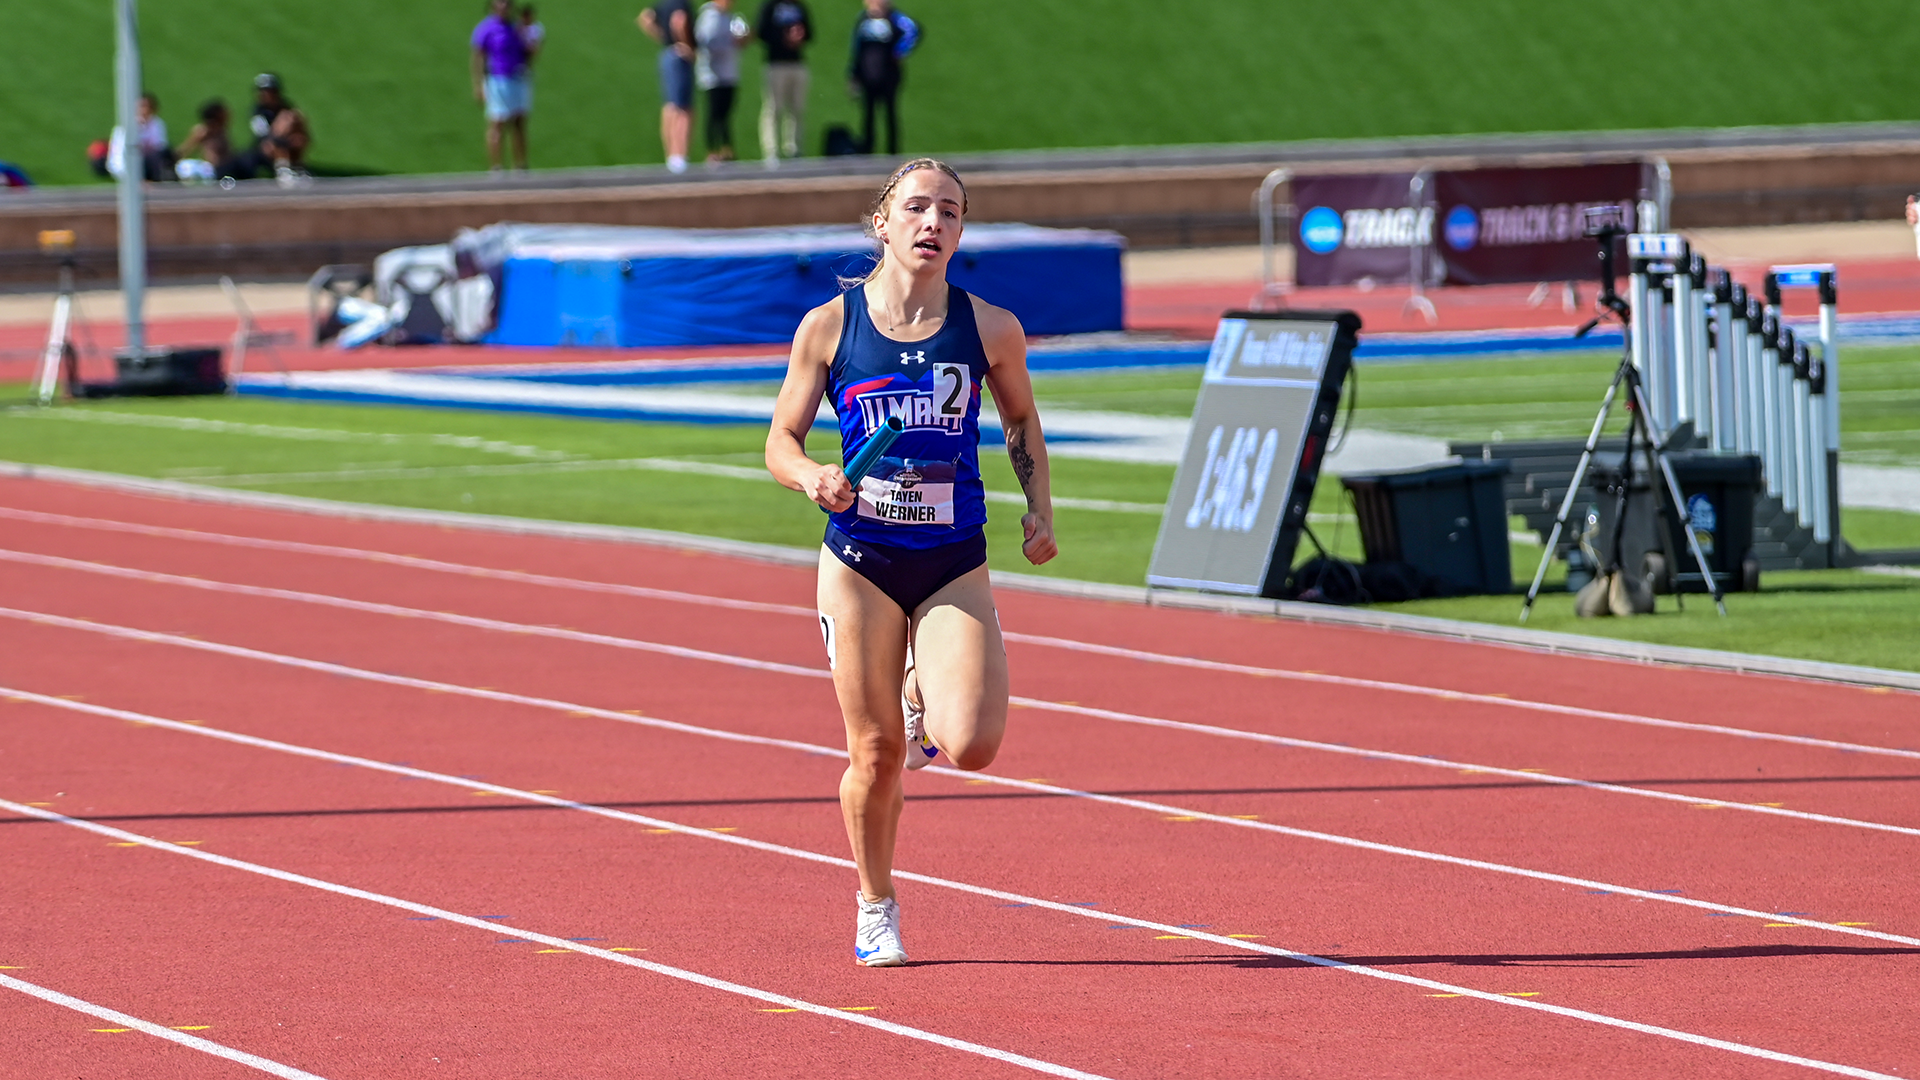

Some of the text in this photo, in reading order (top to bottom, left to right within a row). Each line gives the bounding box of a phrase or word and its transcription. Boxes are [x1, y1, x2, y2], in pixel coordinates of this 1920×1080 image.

[1343, 208, 1434, 248] TRACK
[941, 366, 962, 414] 2
[875, 501, 936, 521] WERNER
[890, 490, 922, 503] TAYEN
